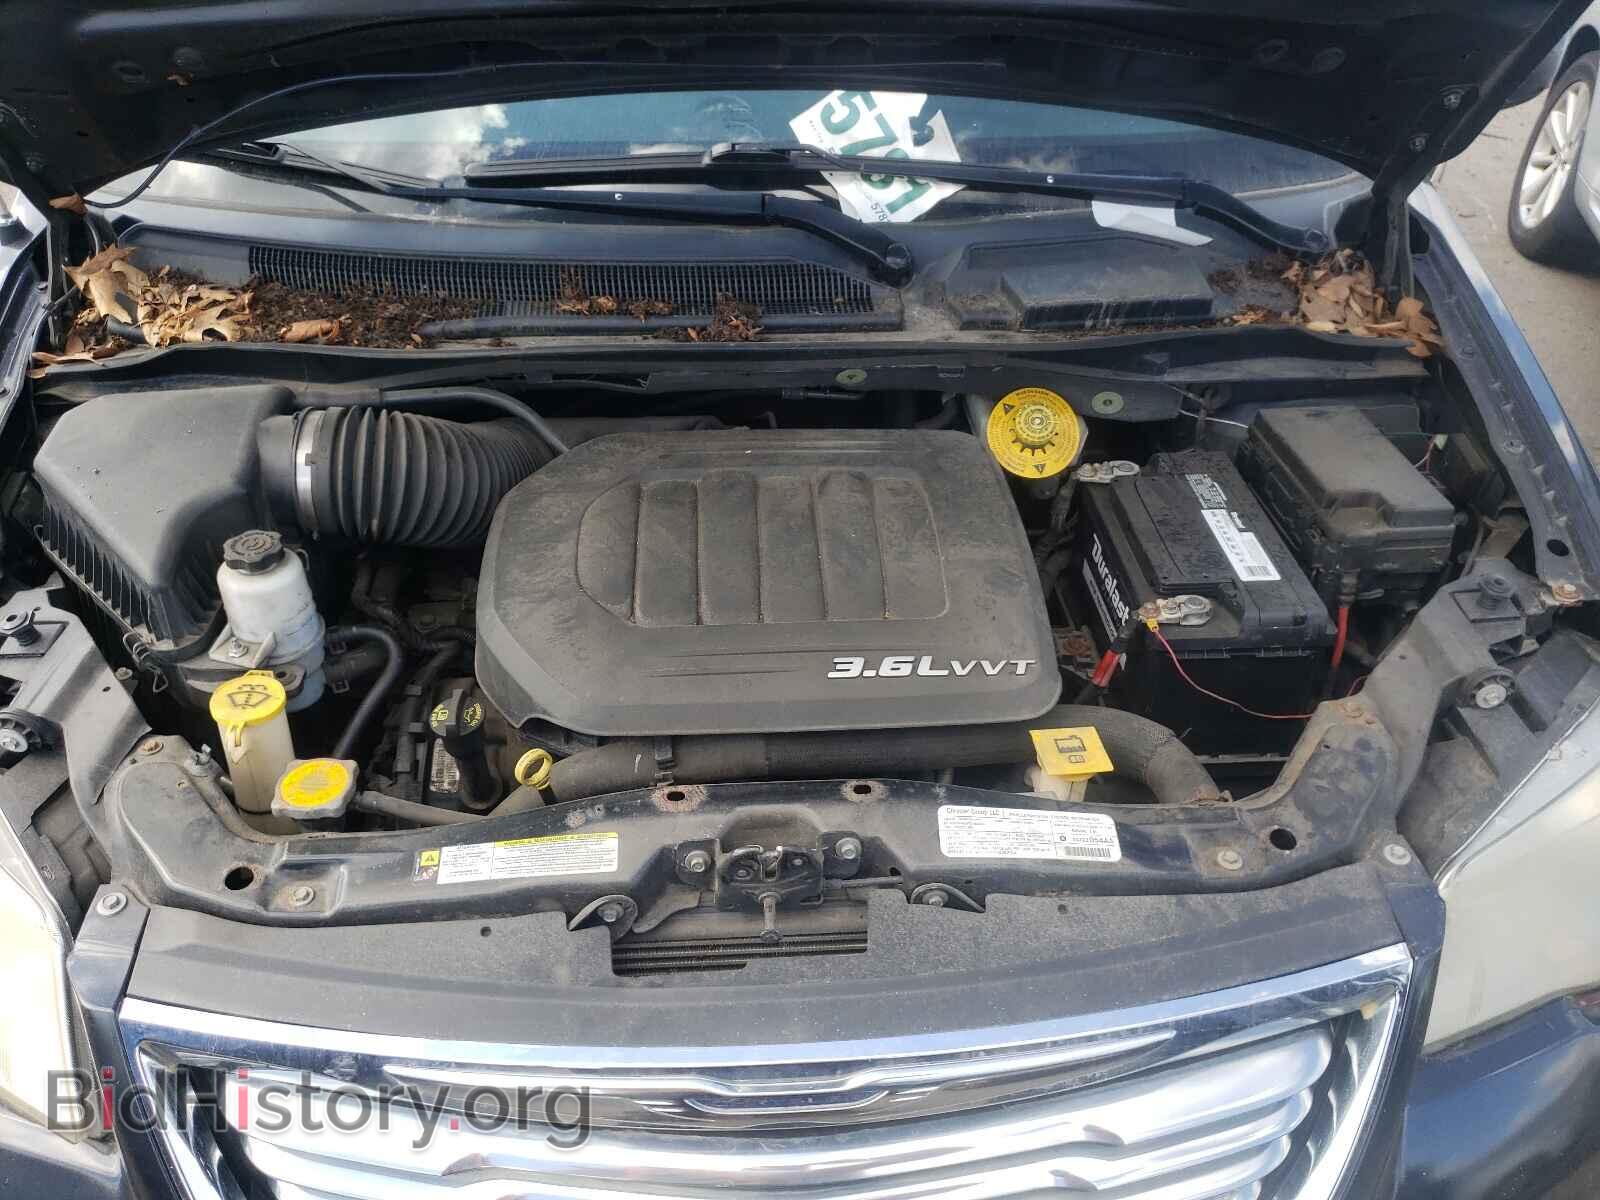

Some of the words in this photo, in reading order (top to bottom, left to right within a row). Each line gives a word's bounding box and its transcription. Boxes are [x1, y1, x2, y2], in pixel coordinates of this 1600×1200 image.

[1092, 533, 1129, 626] Duralast
[827, 655, 950, 678] 3.6L
[950, 659, 1036, 676] VVT
